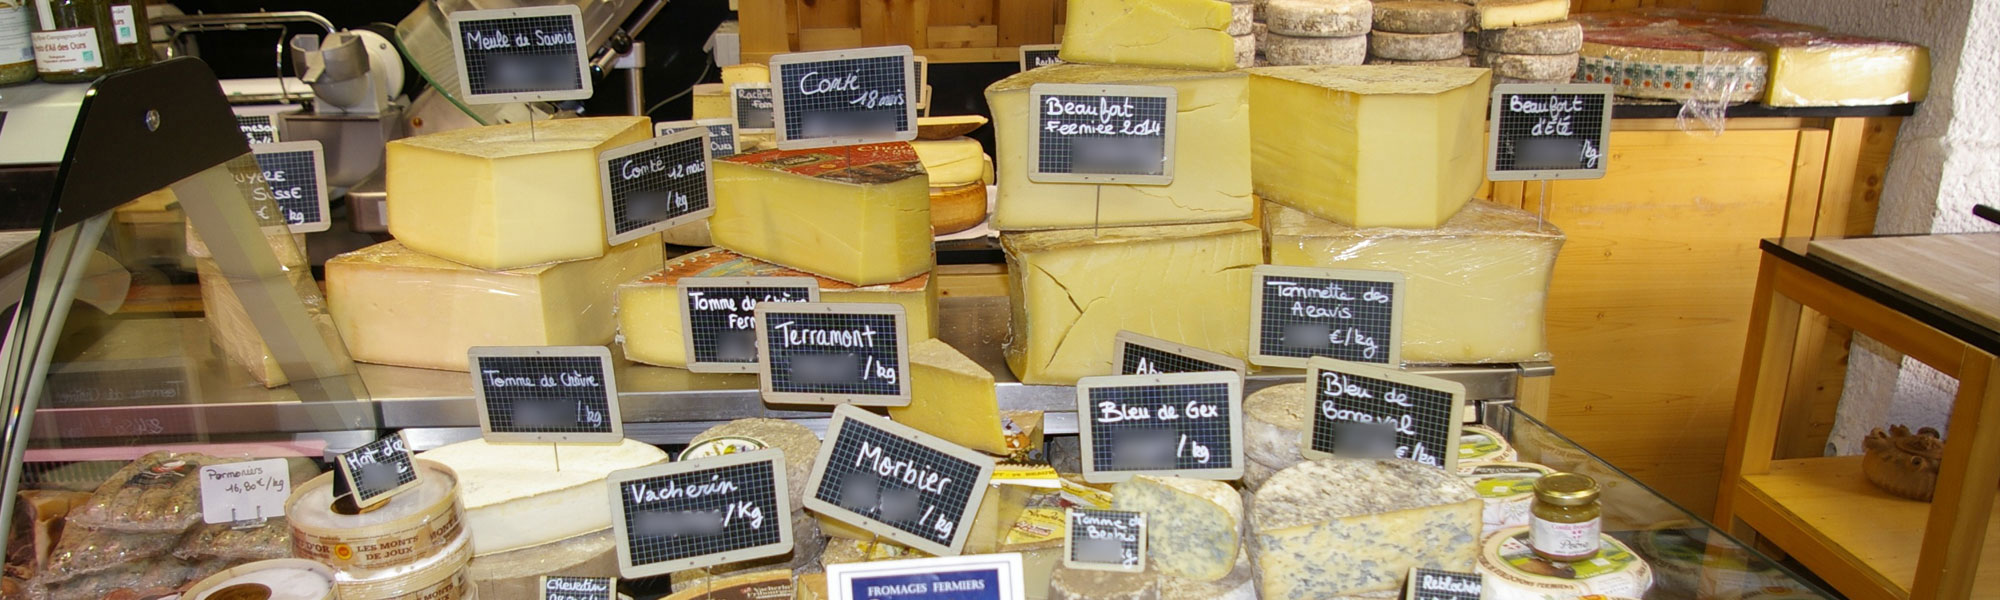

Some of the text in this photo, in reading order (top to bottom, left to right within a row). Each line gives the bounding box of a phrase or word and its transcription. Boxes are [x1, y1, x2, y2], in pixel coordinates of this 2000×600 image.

[70, 41, 87, 50] Ours
[466, 28, 576, 50] Meule de Savoie
[800, 69, 860, 95] Comté
[850, 88, 905, 109] 18 mois
[1045, 96, 1134, 124] Beaufort
[1510, 94, 1583, 121] Beaufort
[1119, 118, 1161, 136] 2014
[622, 155, 706, 180] Comté 12 mois
[688, 291, 738, 312] Tomme
[741, 293, 757, 312] de
[1266, 281, 1389, 304] Tommette des
[774, 320, 877, 348] Terramont
[482, 369, 600, 388] Tomme de Chèvre
[1321, 371, 1415, 408] Bleu de
[1097, 400, 1219, 424] Bleu de Gex
[855, 441, 952, 495] Morbier
[631, 474, 738, 504] Vacherin
[357, 535, 420, 553] LES MONTS
[366, 545, 413, 561] DE JOUX
[867, 579, 986, 597] FROMAGES FERMIERS
